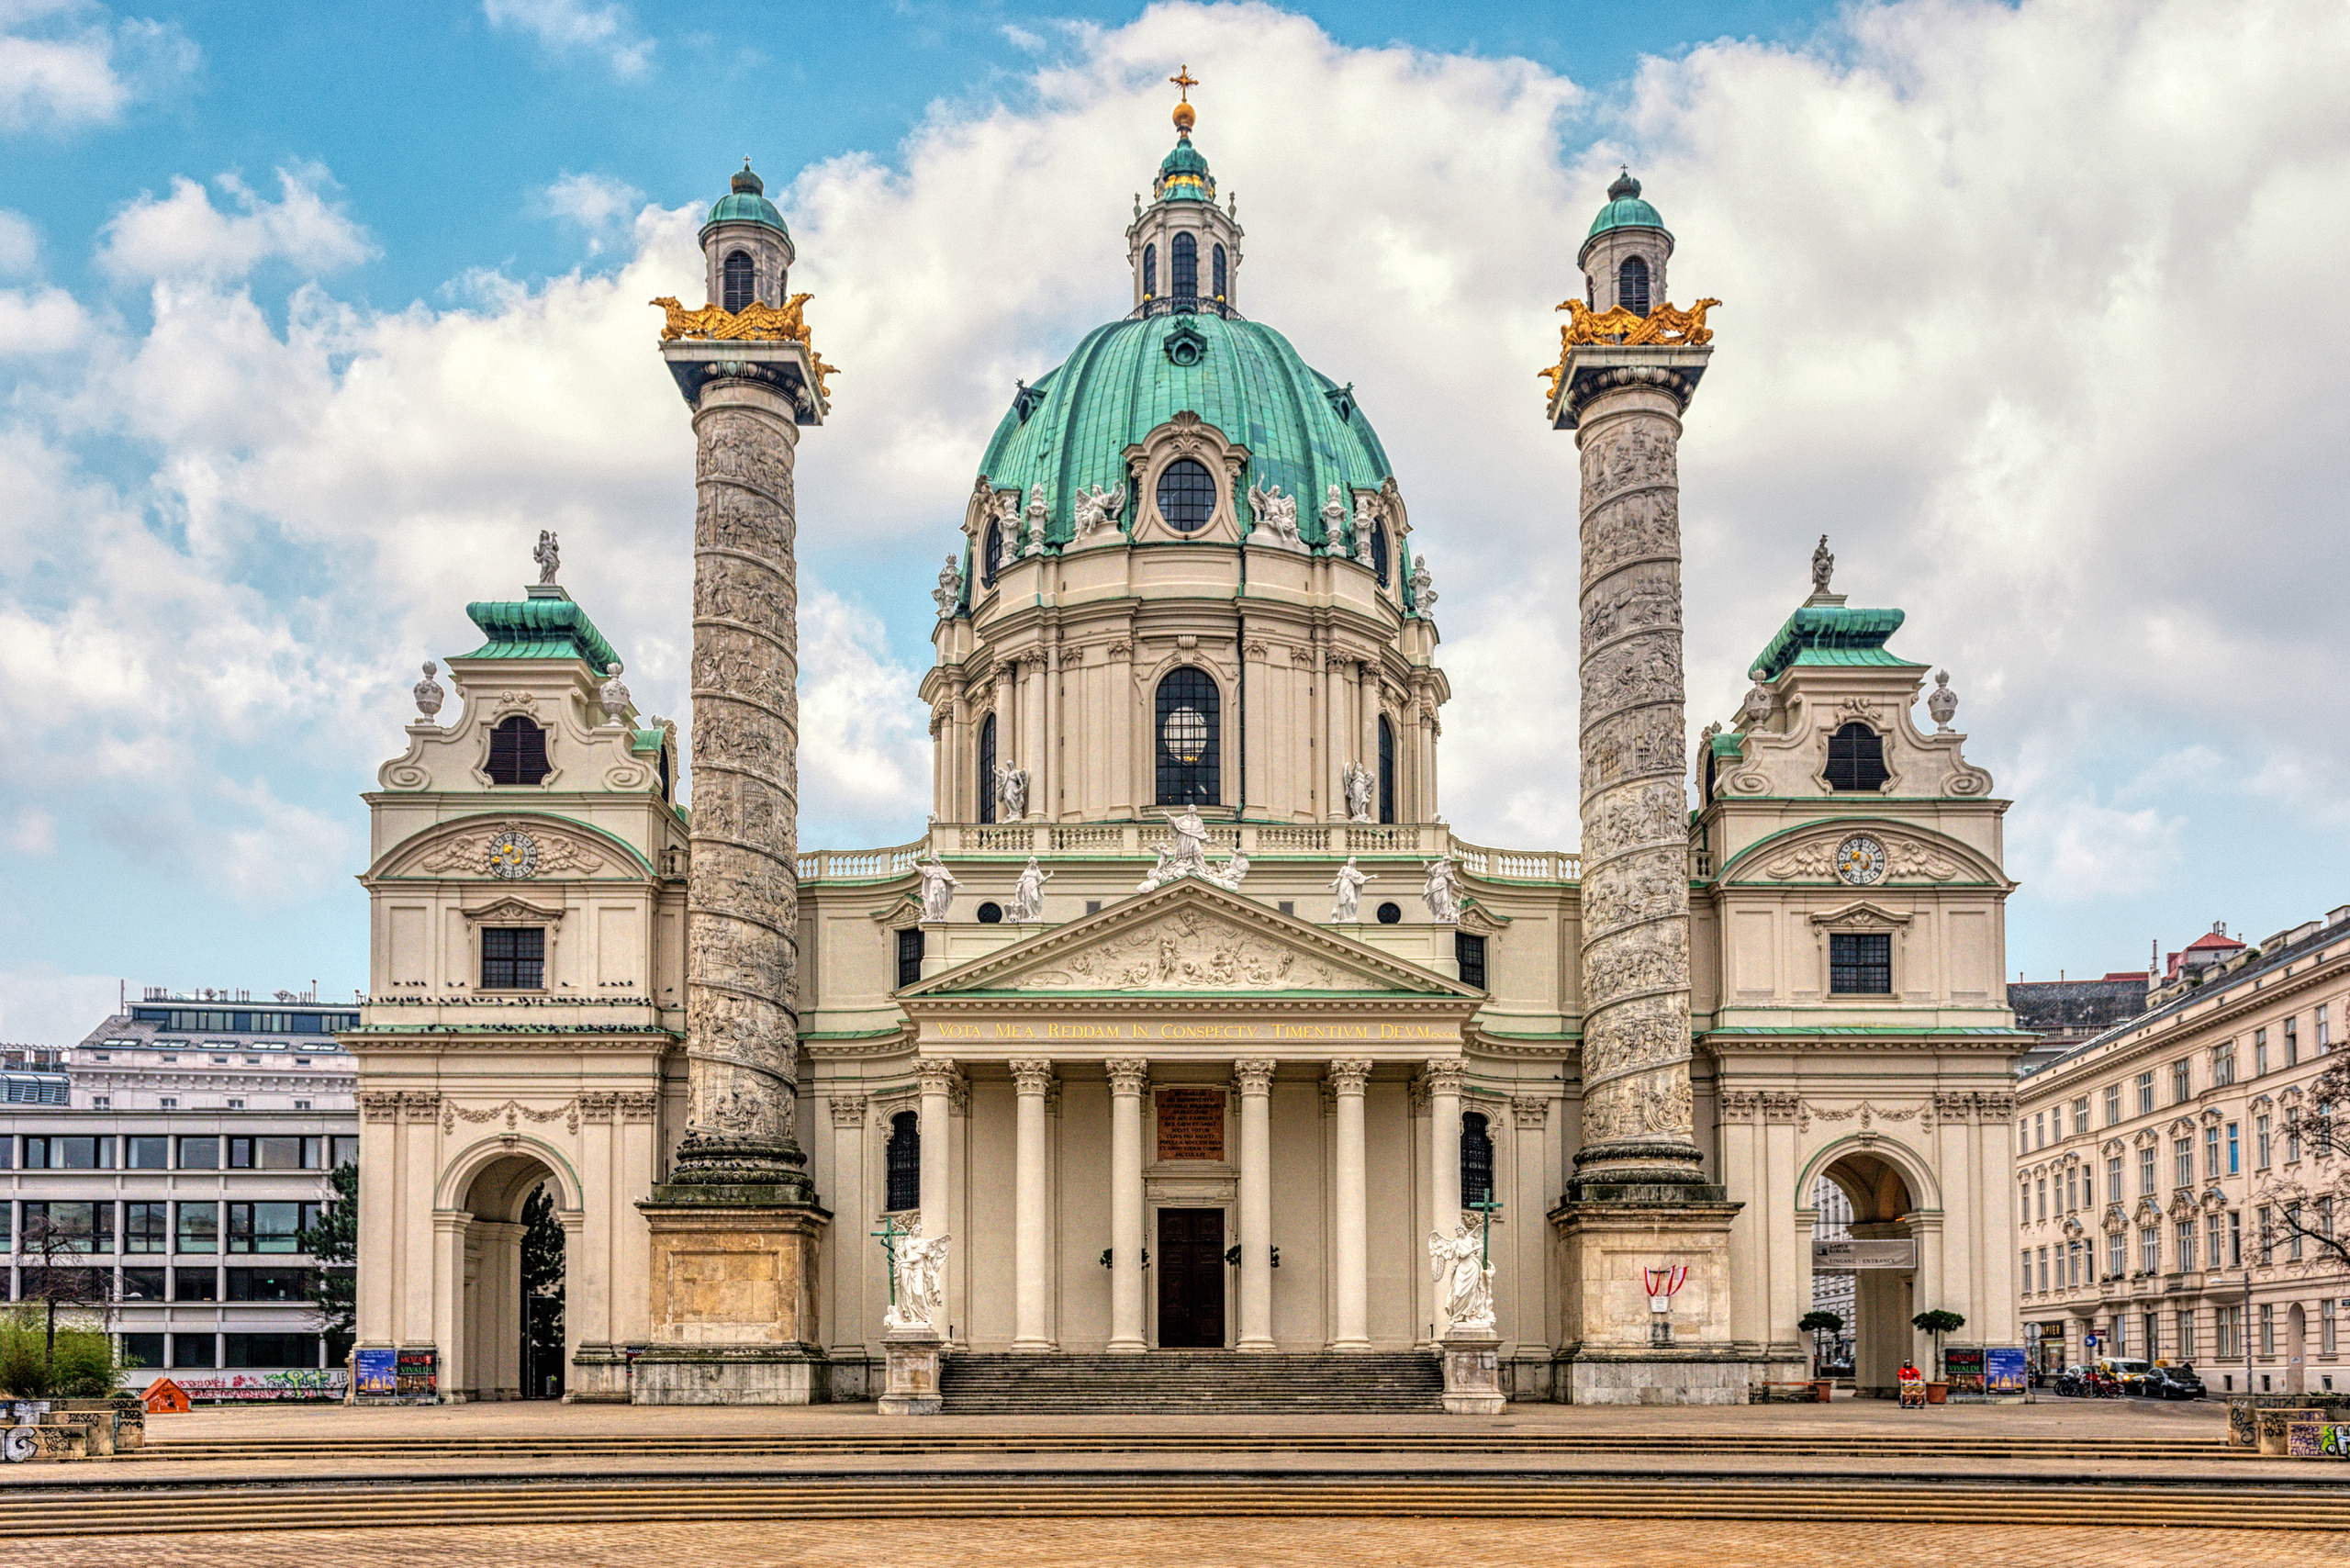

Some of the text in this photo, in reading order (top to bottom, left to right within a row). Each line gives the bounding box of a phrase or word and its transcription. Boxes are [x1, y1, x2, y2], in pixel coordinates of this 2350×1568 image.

[937, 1023, 981, 1038] VOTA
[996, 1024, 1035, 1038] MEA
[1048, 1024, 1119, 1038] REDDAM
[1133, 1024, 1147, 1038] IN
[1161, 1024, 1258, 1039] CONSPECTV
[1271, 1024, 1368, 1039] TIMENTIVM
[1381, 1024, 1429, 1039] DEVM
